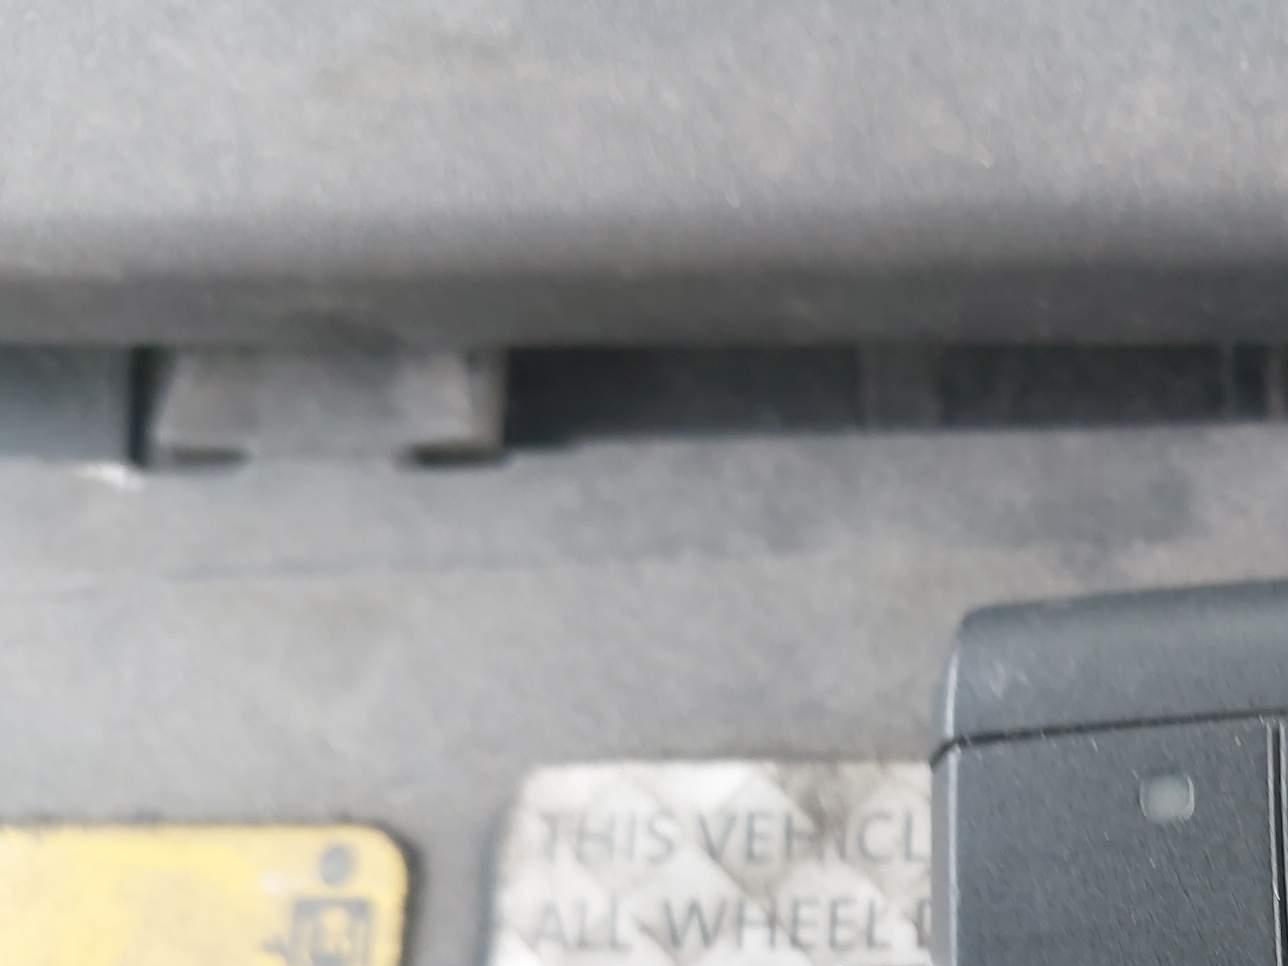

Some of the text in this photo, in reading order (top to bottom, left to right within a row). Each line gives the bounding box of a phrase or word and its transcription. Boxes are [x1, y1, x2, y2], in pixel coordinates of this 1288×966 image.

[537, 810, 676, 866] THIS
[533, 897, 634, 951] ALL
[661, 896, 890, 951] WHEEL
